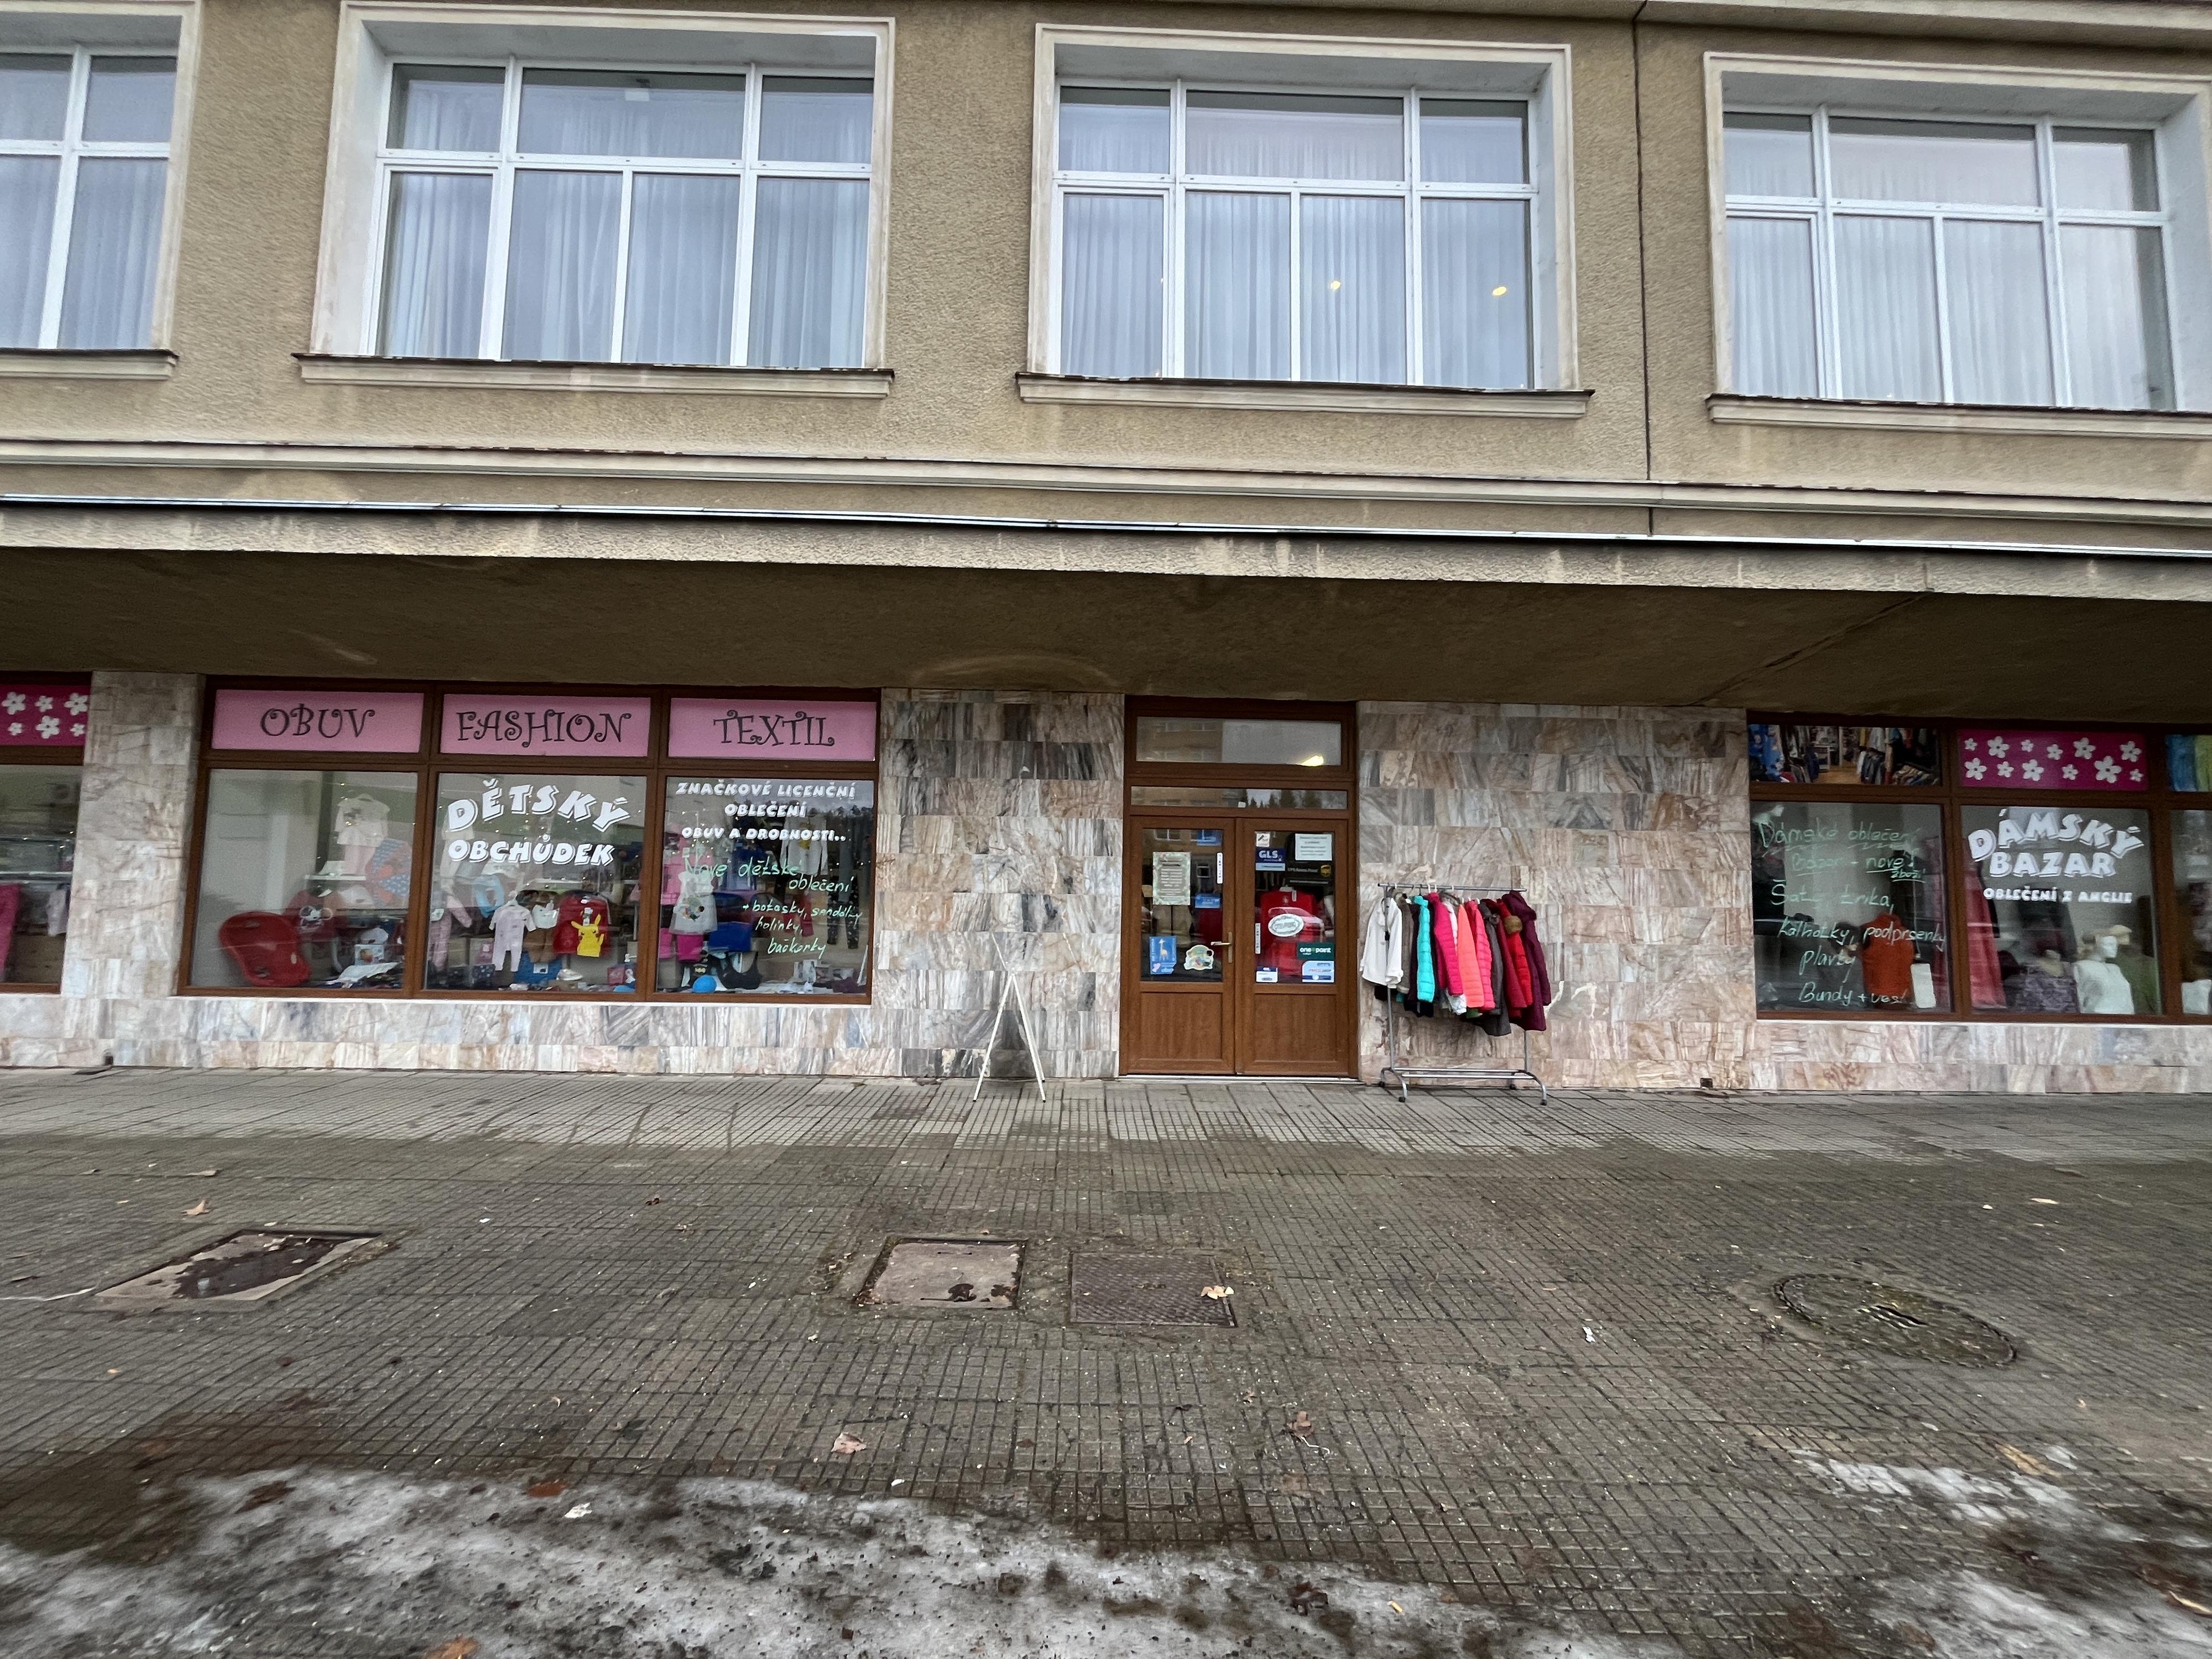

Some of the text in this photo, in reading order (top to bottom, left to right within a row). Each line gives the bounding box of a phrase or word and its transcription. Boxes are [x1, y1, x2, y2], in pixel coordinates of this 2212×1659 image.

[260, 703, 375, 738] OBUV
[456, 709, 632, 748] FASHION
[713, 709, 835, 747] TEXTIL
[675, 779, 856, 799] ZNAČKOVÉ LICENČNÍ
[447, 778, 630, 832] DĚTSKÝ
[724, 801, 807, 817] OBLEČENÍ
[681, 827, 724, 838] OBUV
[729, 828, 740, 839] A
[1968, 809, 2144, 862] DÁMSKÝ
[448, 834, 615, 866] OBCHŮDEK
[1989, 852, 2116, 878] BAZAR
[789, 873, 854, 893] oblečení
[1983, 885, 2133, 904] OBLEČENÍ Z ANGLIE
